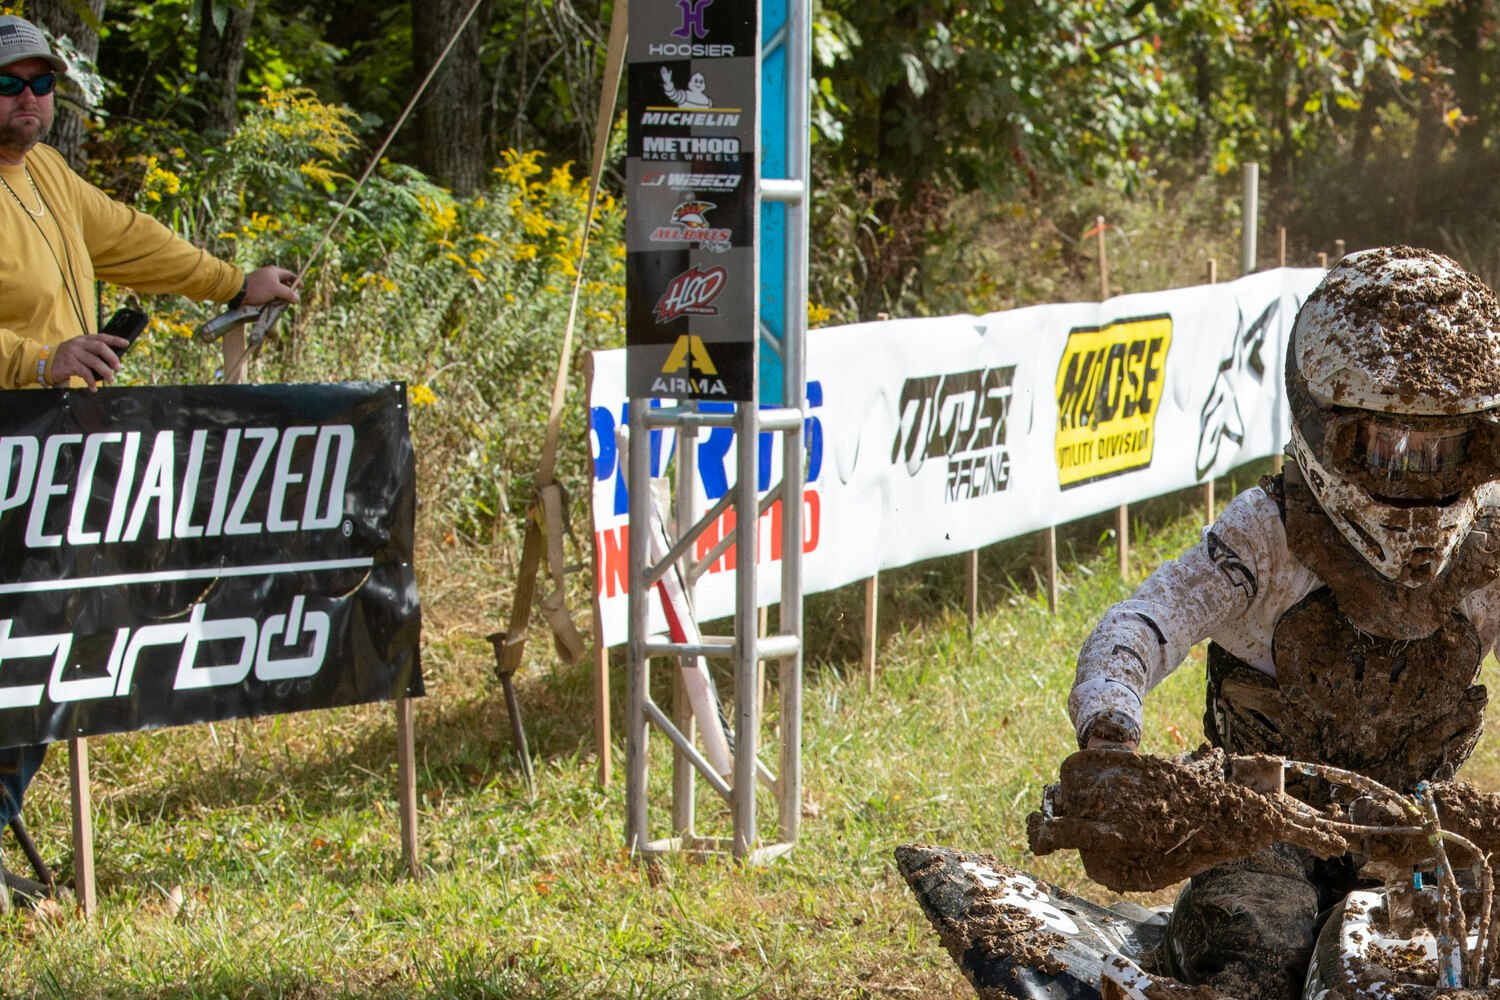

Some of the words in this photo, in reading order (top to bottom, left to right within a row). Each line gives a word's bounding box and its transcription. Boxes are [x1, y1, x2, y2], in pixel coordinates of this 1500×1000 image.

[649, 44, 735, 57] HOOSIER
[641, 112, 740, 127] MICHELIN
[643, 137, 740, 154] METHOD
[643, 152, 677, 160] RACE
[685, 153, 740, 162] WHEELS
[683, 228, 731, 242] BALLS
[665, 271, 723, 312] HBD
[651, 377, 727, 395] ARMA
[1098, 428, 1149, 460] DIVISION
